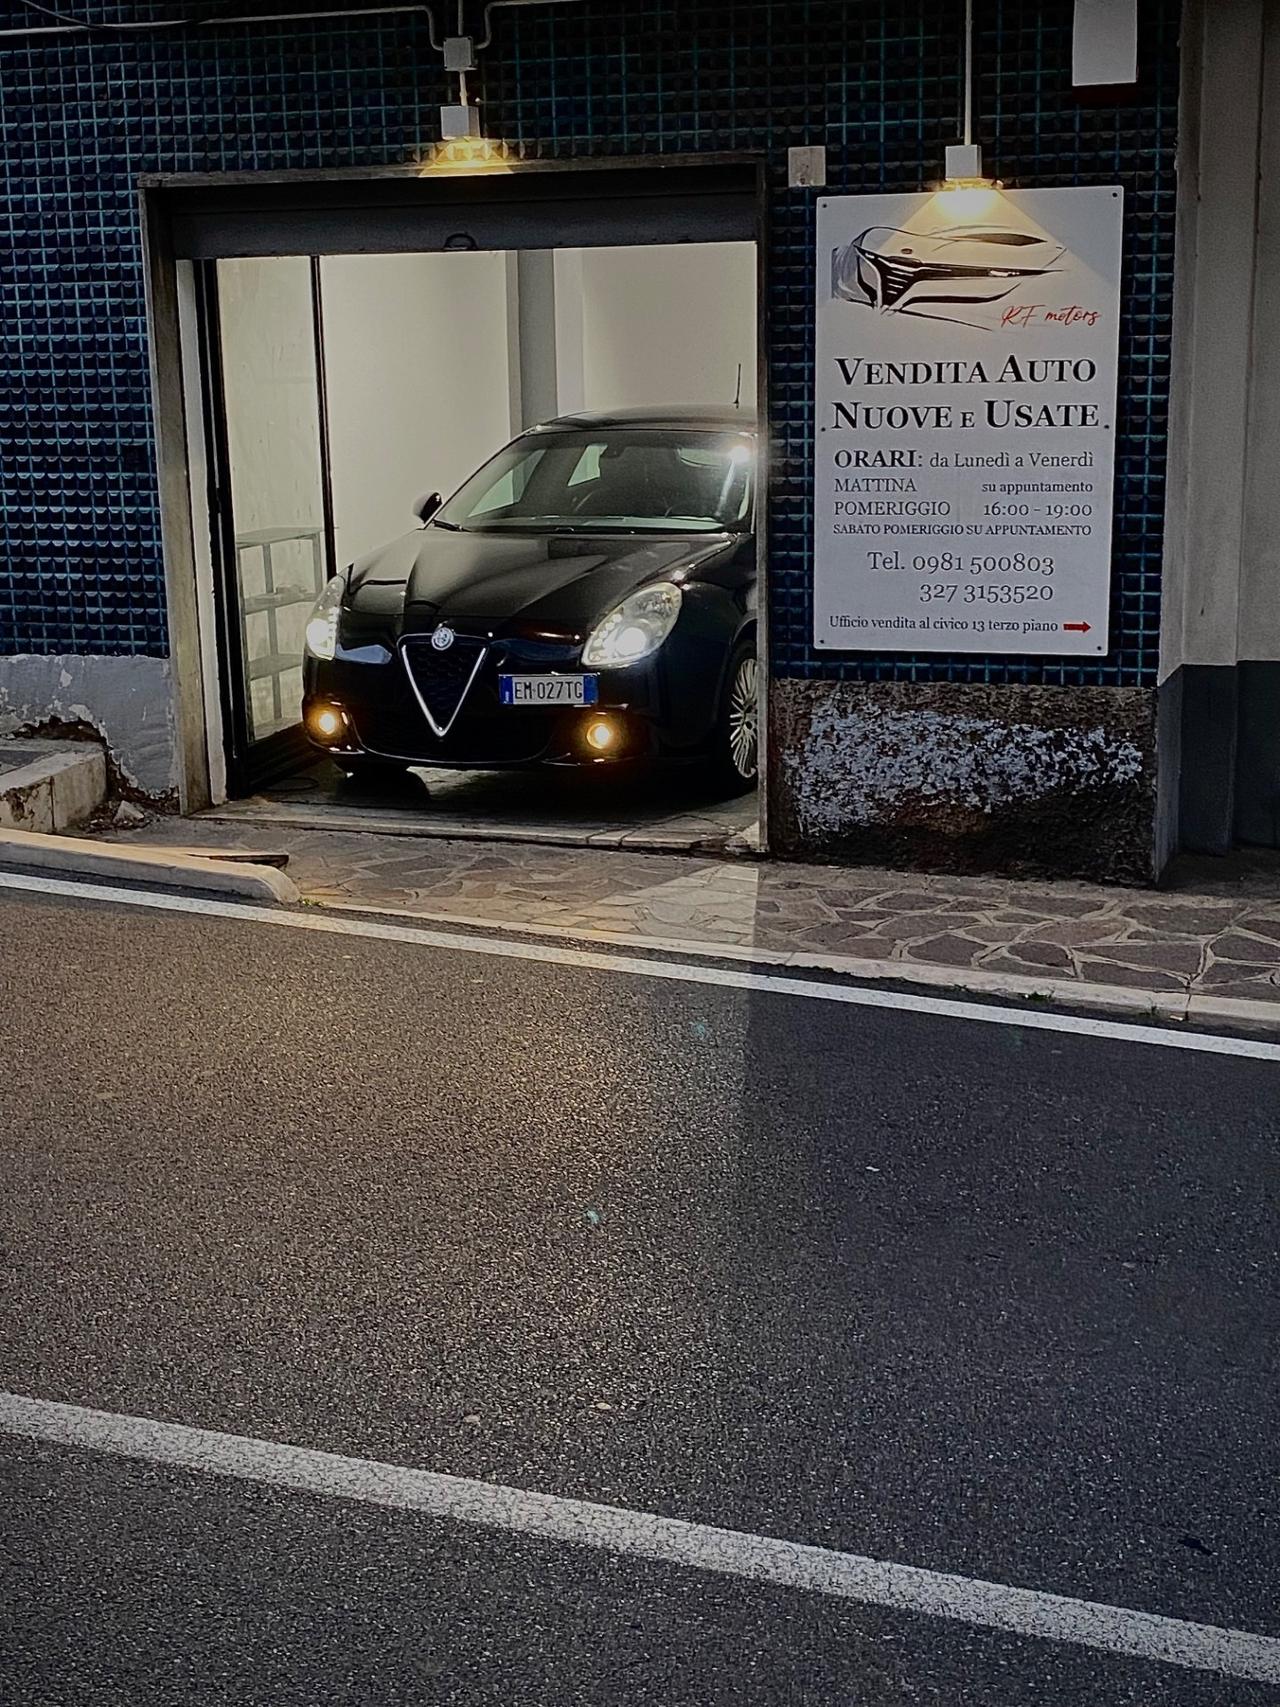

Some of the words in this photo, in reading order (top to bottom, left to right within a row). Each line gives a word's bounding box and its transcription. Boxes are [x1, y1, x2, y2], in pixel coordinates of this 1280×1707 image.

[1044, 304, 1102, 327] motors
[834, 357, 989, 385] VENDITA
[995, 354, 1097, 383] AUTO
[831, 401, 952, 429] NUOVE
[959, 410, 975, 428] E
[984, 399, 1100, 428] USATE
[834, 449, 923, 468] ORARI:
[929, 452, 949, 468] da
[954, 451, 1010, 468] Lunedì
[1014, 456, 1024, 468] a
[1028, 451, 1094, 468] Venerdì
[834, 477, 918, 493] MATTINA
[981, 483, 997, 493] su
[1000, 481, 1094, 496] appuntamento
[834, 500, 951, 516] POMERIGGIO
[983, 503, 1029, 517] 16:00
[1045, 503, 1093, 519] 19:00
[833, 523, 881, 535] SABATO
[883, 523, 964, 536] POMERIGGIO
[966, 524, 983, 536] SU
[985, 524, 1092, 537] APPUNTAMENTO
[867, 551, 906, 571] Tel.
[912, 551, 963, 575] 0981
[969, 552, 1055, 576] 500803
[919, 583, 959, 604] 327
[963, 584, 1054, 605] 3153520
[829, 615, 868, 629] Ufficio
[871, 616, 917, 630] vendita
[918, 616, 931, 630] al
[933, 617, 969, 631] civico
[971, 620, 986, 633] 13
[988, 620, 1020, 633] terzo
[1022, 619, 1059, 635] piano
